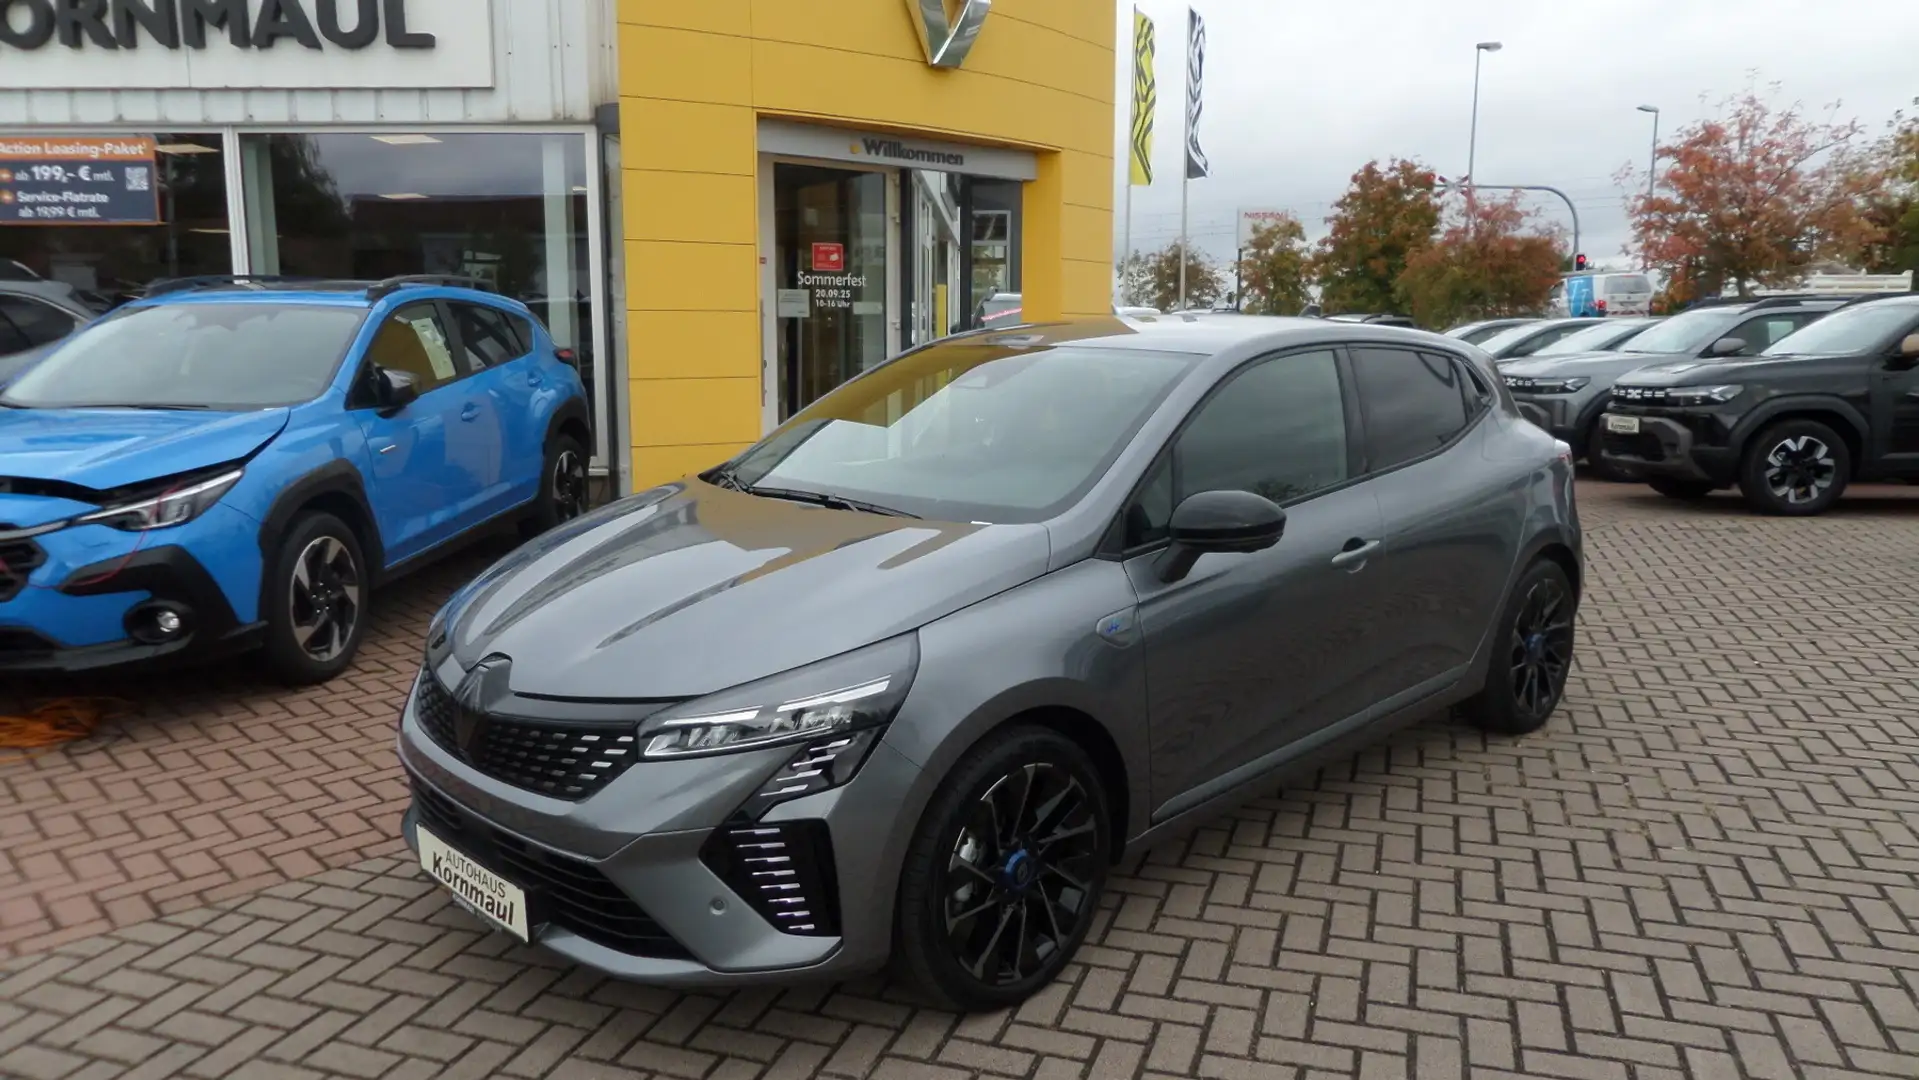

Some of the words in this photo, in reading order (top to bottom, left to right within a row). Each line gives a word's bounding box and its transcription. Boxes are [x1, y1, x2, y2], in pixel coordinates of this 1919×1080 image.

[862, 138, 964, 166] Willkommen
[15, 170, 29, 182] ab
[78, 165, 92, 181] €
[93, 170, 115, 182] mtl.
[17, 191, 109, 203] Service-Flatrate
[19, 206, 33, 218] ab
[66, 206, 76, 218] €
[77, 206, 101, 218] mtl.
[798, 271, 867, 287] Sommerfest
[816, 289, 851, 299] 20.09.25
[816, 299, 836, 308] 10-16
[837, 299, 851, 308] Uhr
[445, 850, 506, 899] AUTOHAUS
[433, 851, 514, 926] Kornmaul
